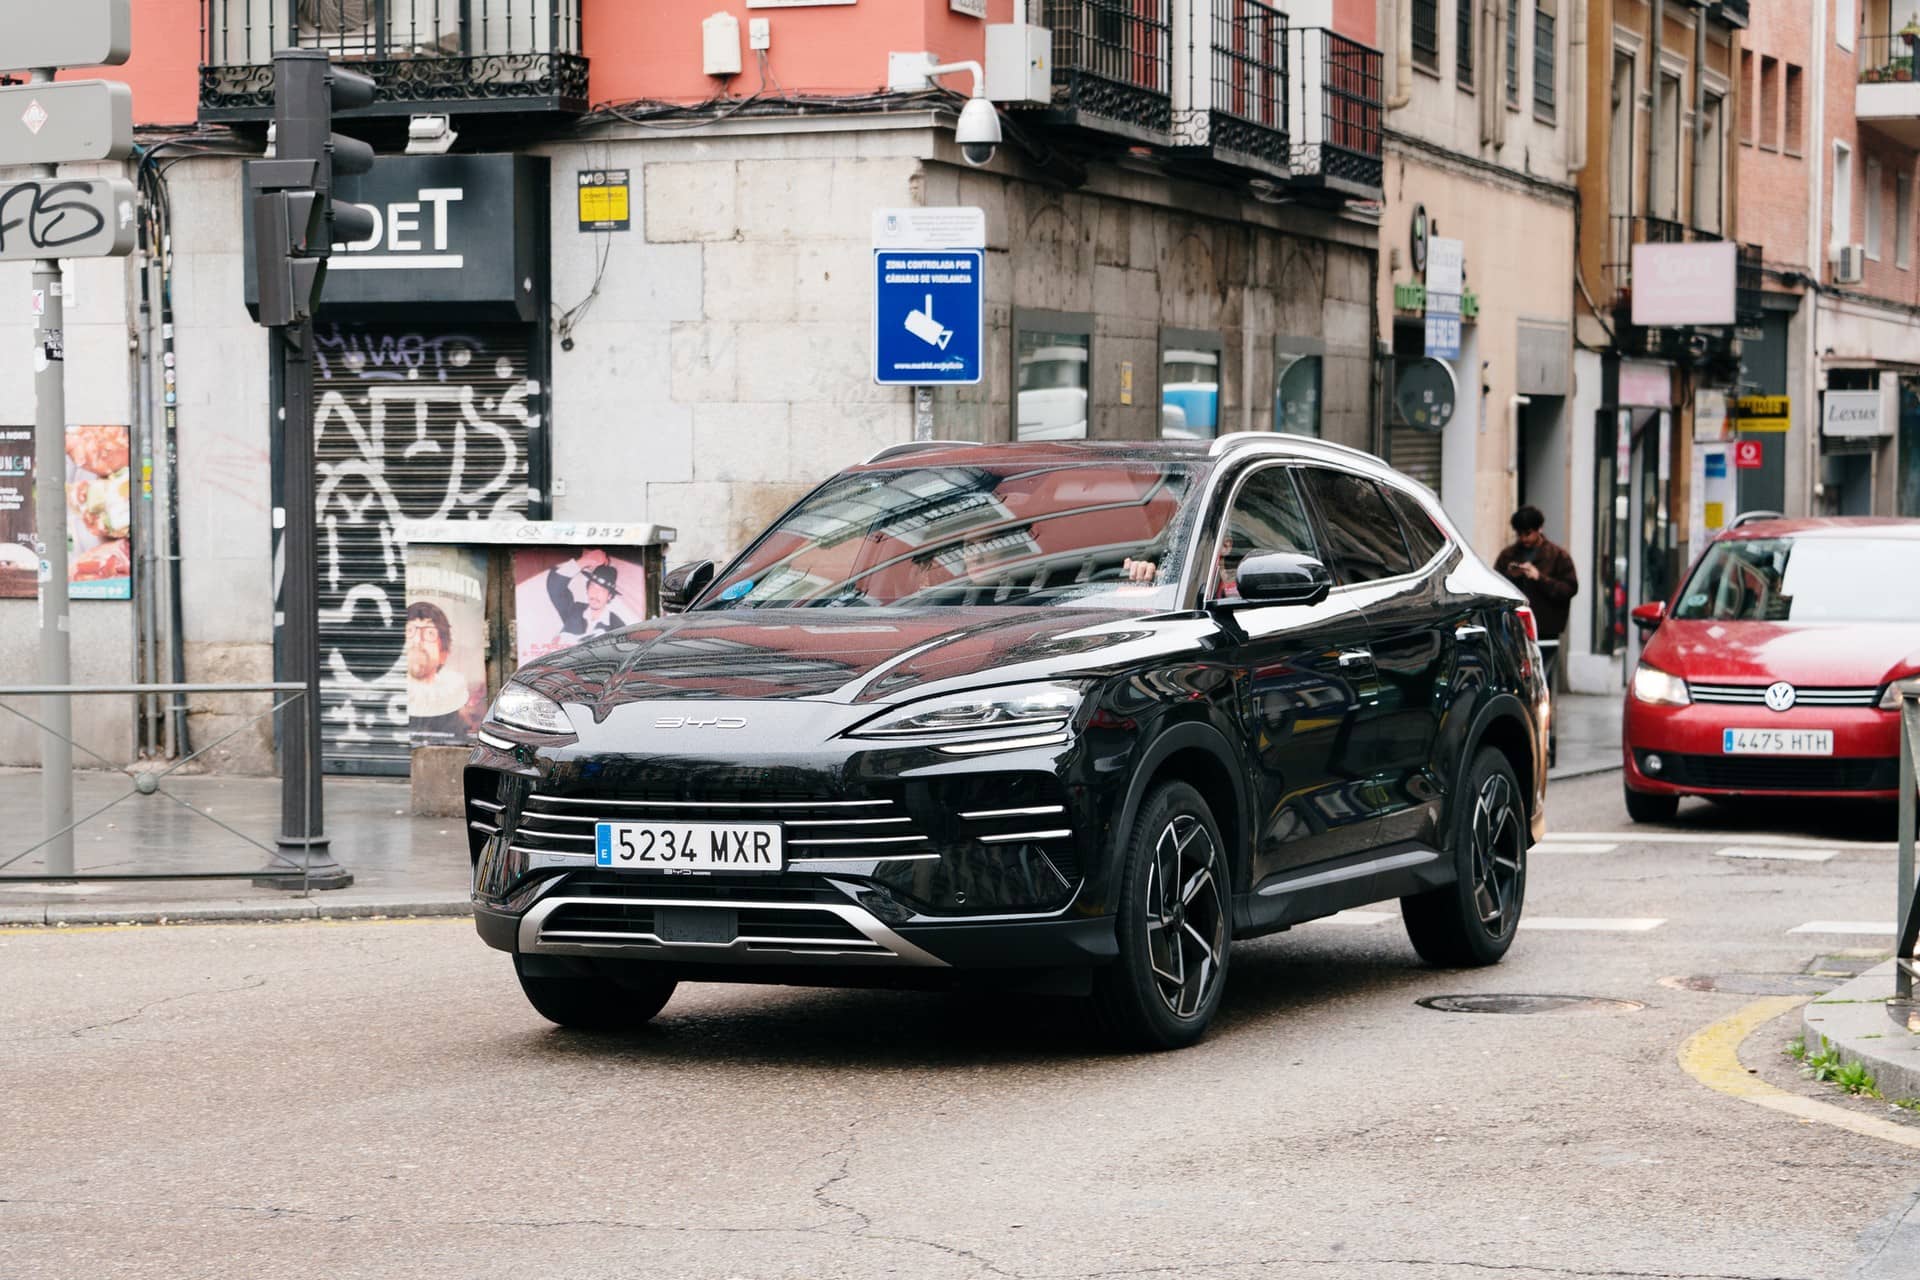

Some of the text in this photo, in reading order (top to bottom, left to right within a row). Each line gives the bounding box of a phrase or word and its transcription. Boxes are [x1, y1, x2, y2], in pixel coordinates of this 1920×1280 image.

[885, 259, 972, 270] ZONA CONTROLADA POR
[919, 273, 931, 283] DE
[931, 273, 972, 283] VIGILANCIA
[1828, 405, 1878, 422] Lexus
[655, 716, 748, 728] BYD
[1737, 733, 1828, 751] 4475 HTH
[619, 828, 697, 862] 5234
[710, 830, 771, 864] MXR
